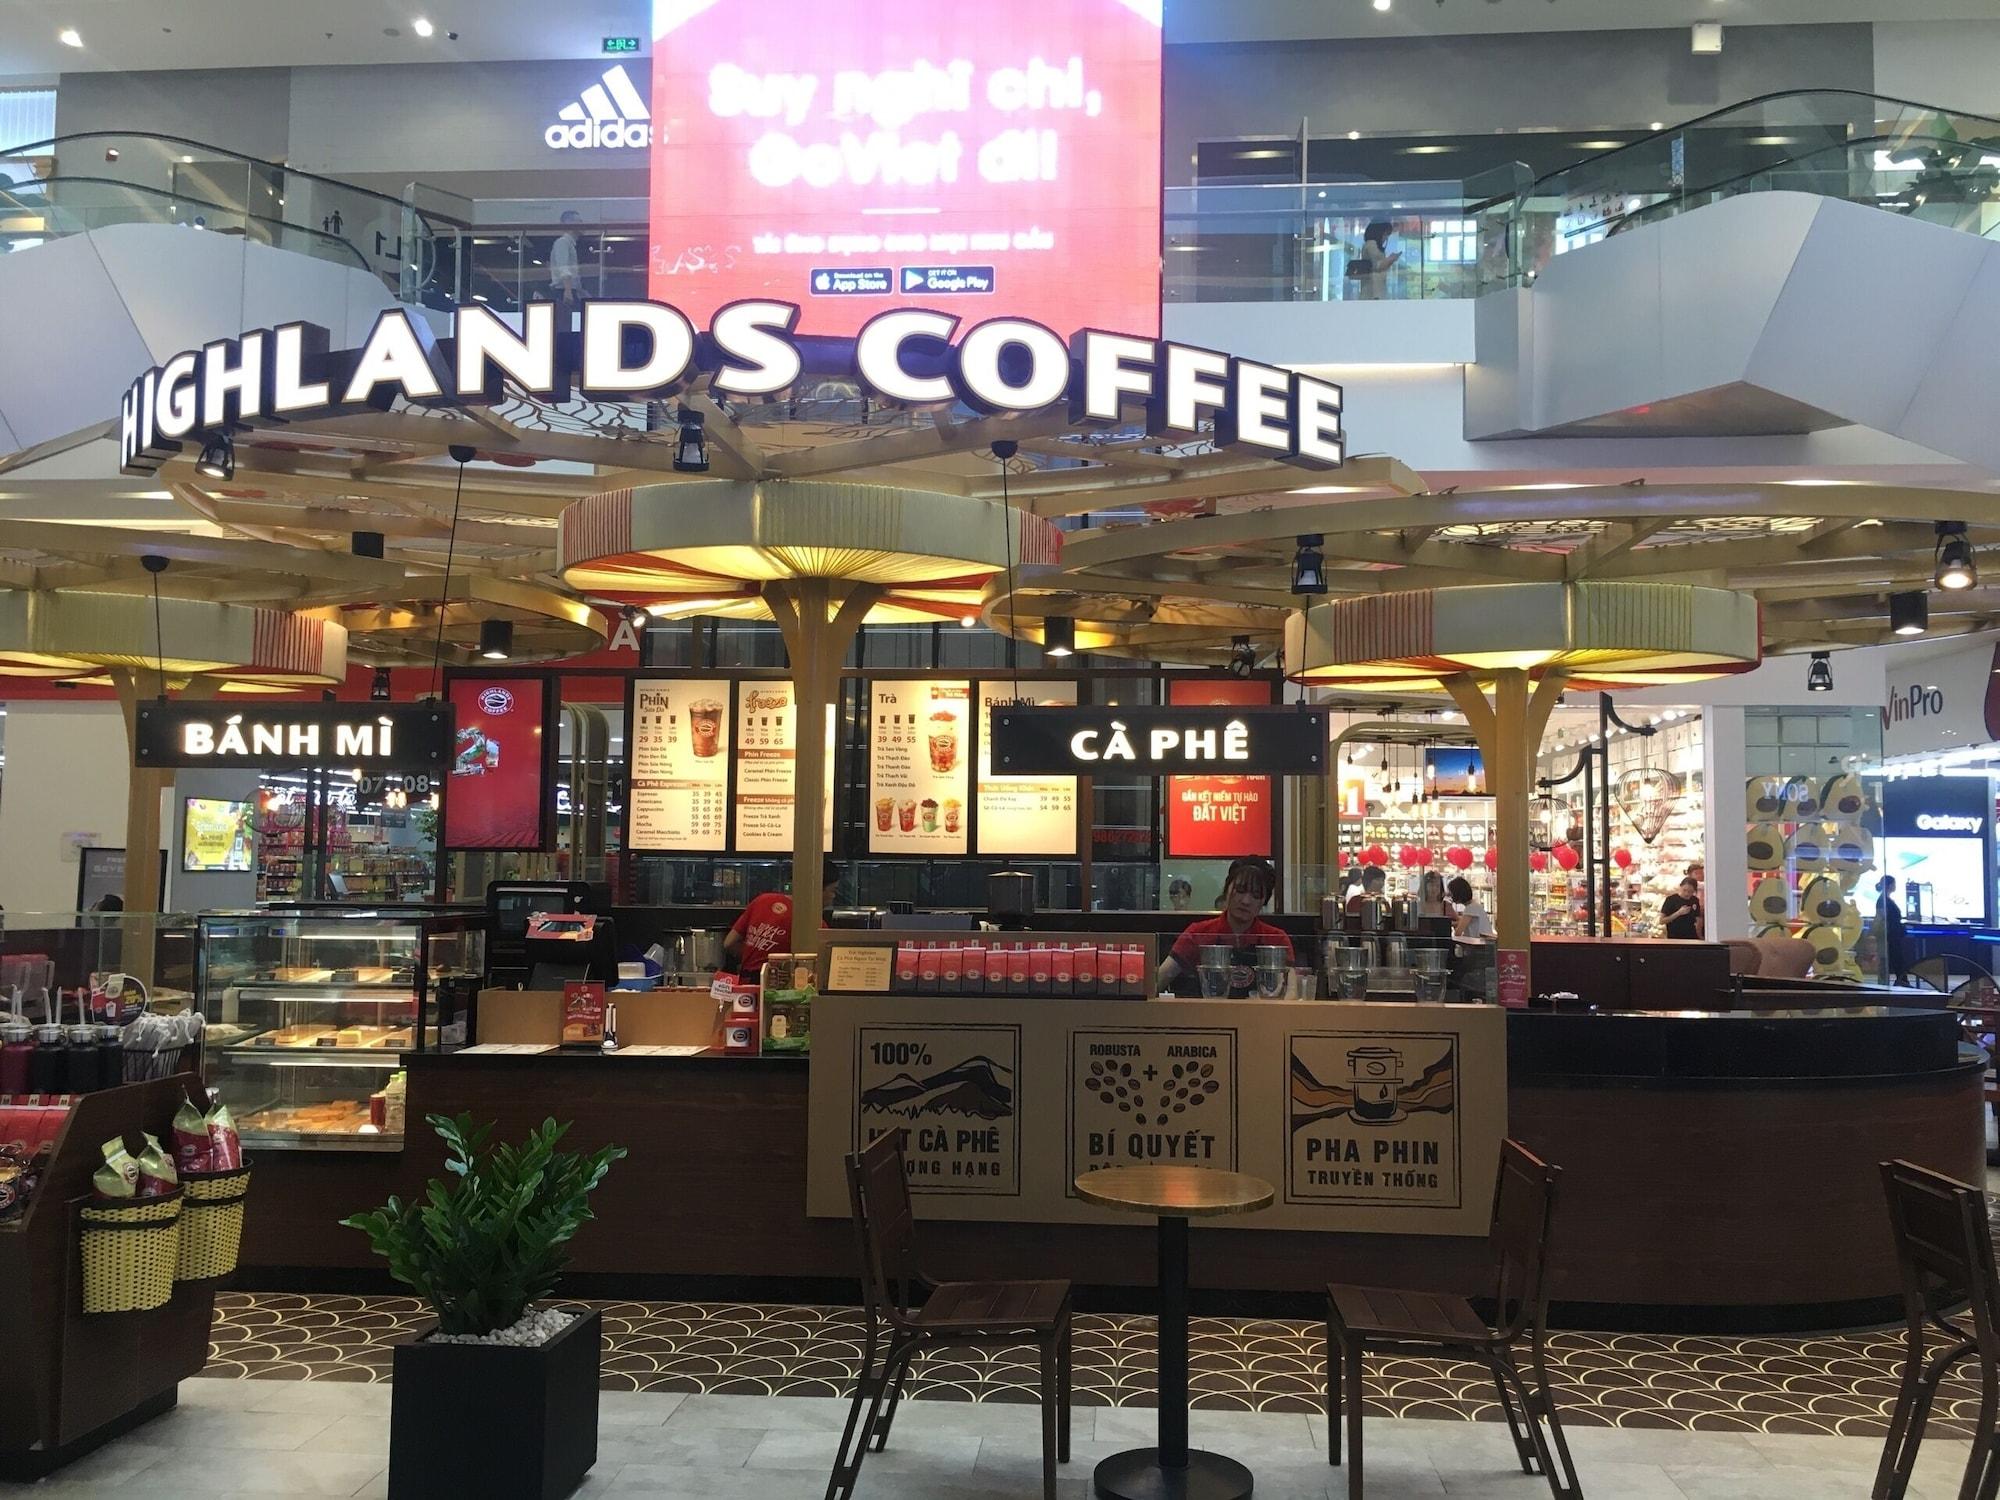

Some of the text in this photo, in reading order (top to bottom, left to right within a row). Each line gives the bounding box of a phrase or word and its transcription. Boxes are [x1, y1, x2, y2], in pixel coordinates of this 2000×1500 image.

[832, 278, 887, 291] App Store
[927, 276, 989, 291] Google Play
[120, 302, 1342, 474] HIGHLANDS COFFEE
[879, 693, 897, 703] Trà
[985, 697, 1014, 707] Bánh
[1882, 684, 1943, 730] VinPro
[184, 714, 394, 756] BÁNH MÌ
[1070, 720, 1249, 761] CÀ PHÊ
[359, 775, 429, 794] 07 08
[1220, 803, 1247, 825] VIỆT
[1916, 814, 1983, 834] Galaxy
[870, 1042, 932, 1066] 100%
[1089, 1044, 1141, 1057] ROBUSTA
[1167, 1045, 1218, 1058] ARABICA
[868, 1125, 1000, 1153] HT CÀ PHÊ
[1089, 1128, 1215, 1160] BÍ QUYẾT
[1306, 1138, 1438, 1164] PHA PHIN
[952, 1161, 1000, 1178] HẠNG
[1307, 1168, 1438, 1188] TRUYỀN THỐNG
